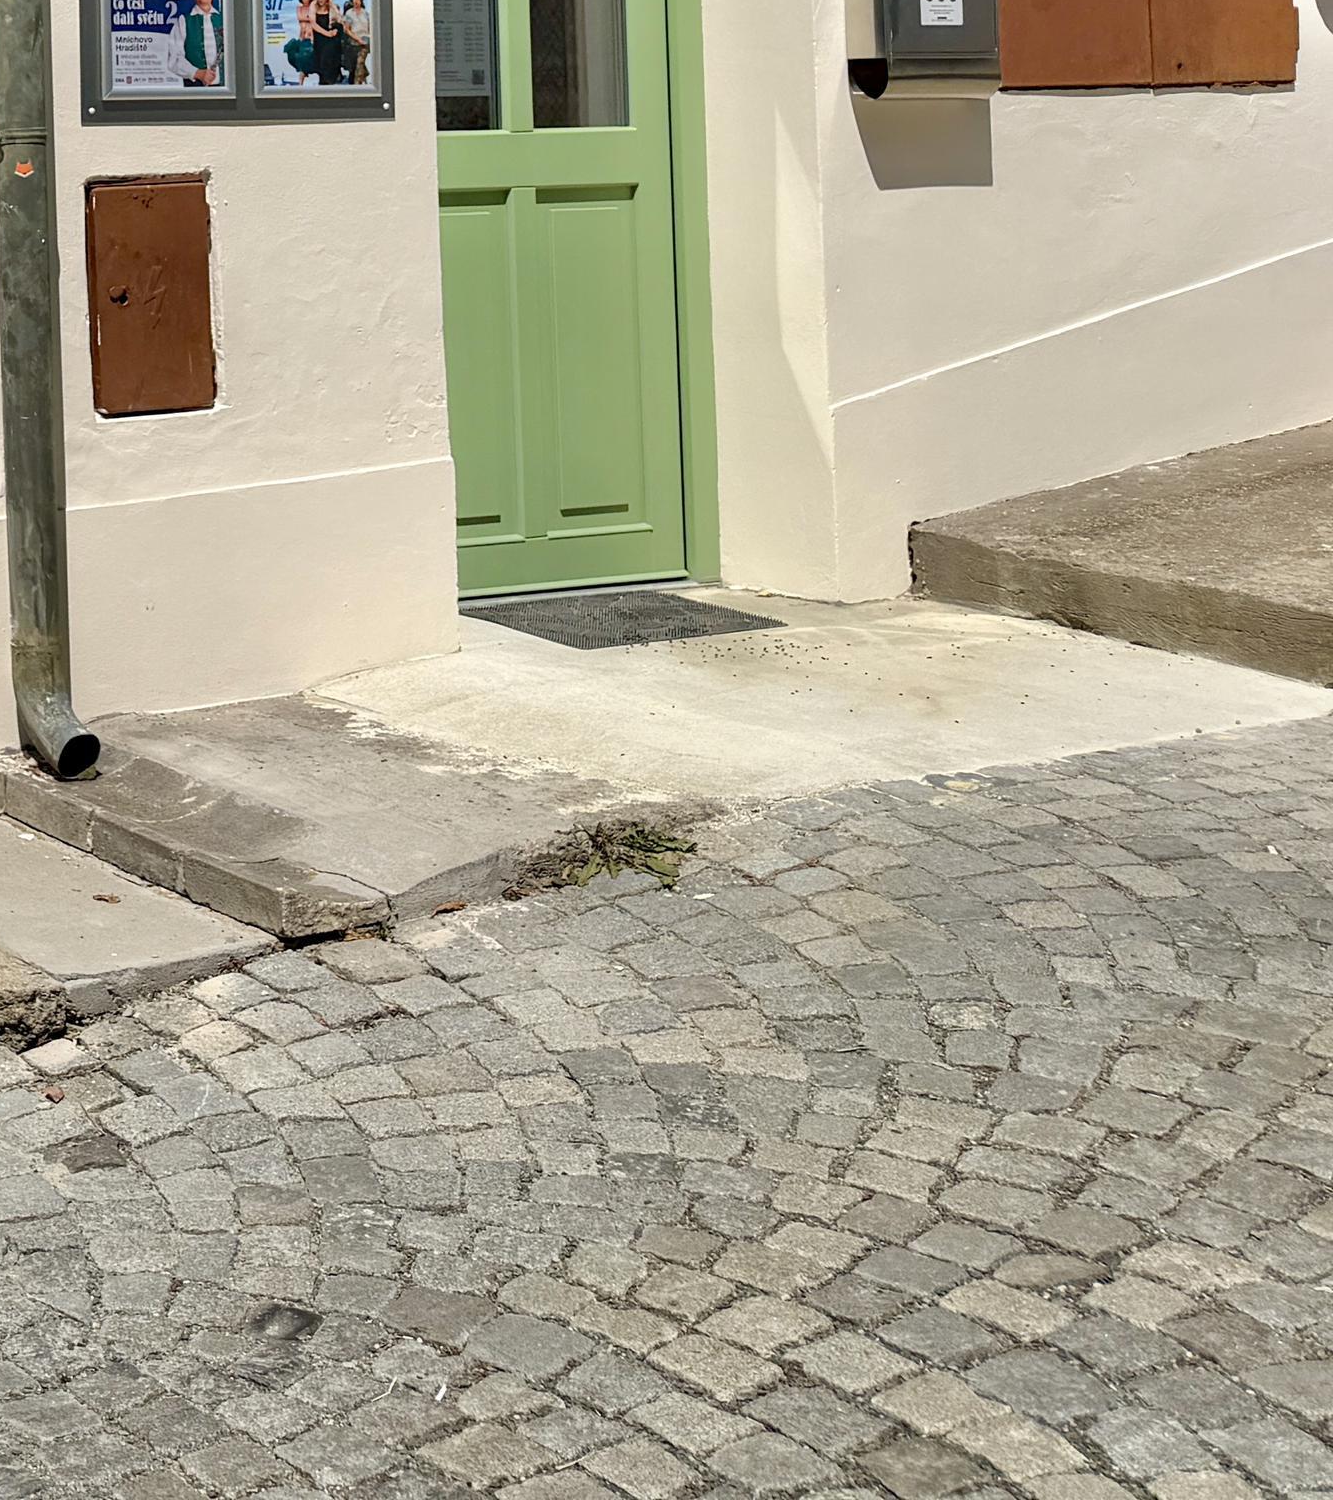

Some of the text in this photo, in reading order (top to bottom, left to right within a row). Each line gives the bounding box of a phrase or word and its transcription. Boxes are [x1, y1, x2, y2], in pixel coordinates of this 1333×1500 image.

[113, 11, 134, 25] dali
[137, 10, 164, 25] světu
[115, 44, 148, 52] Hradiště
